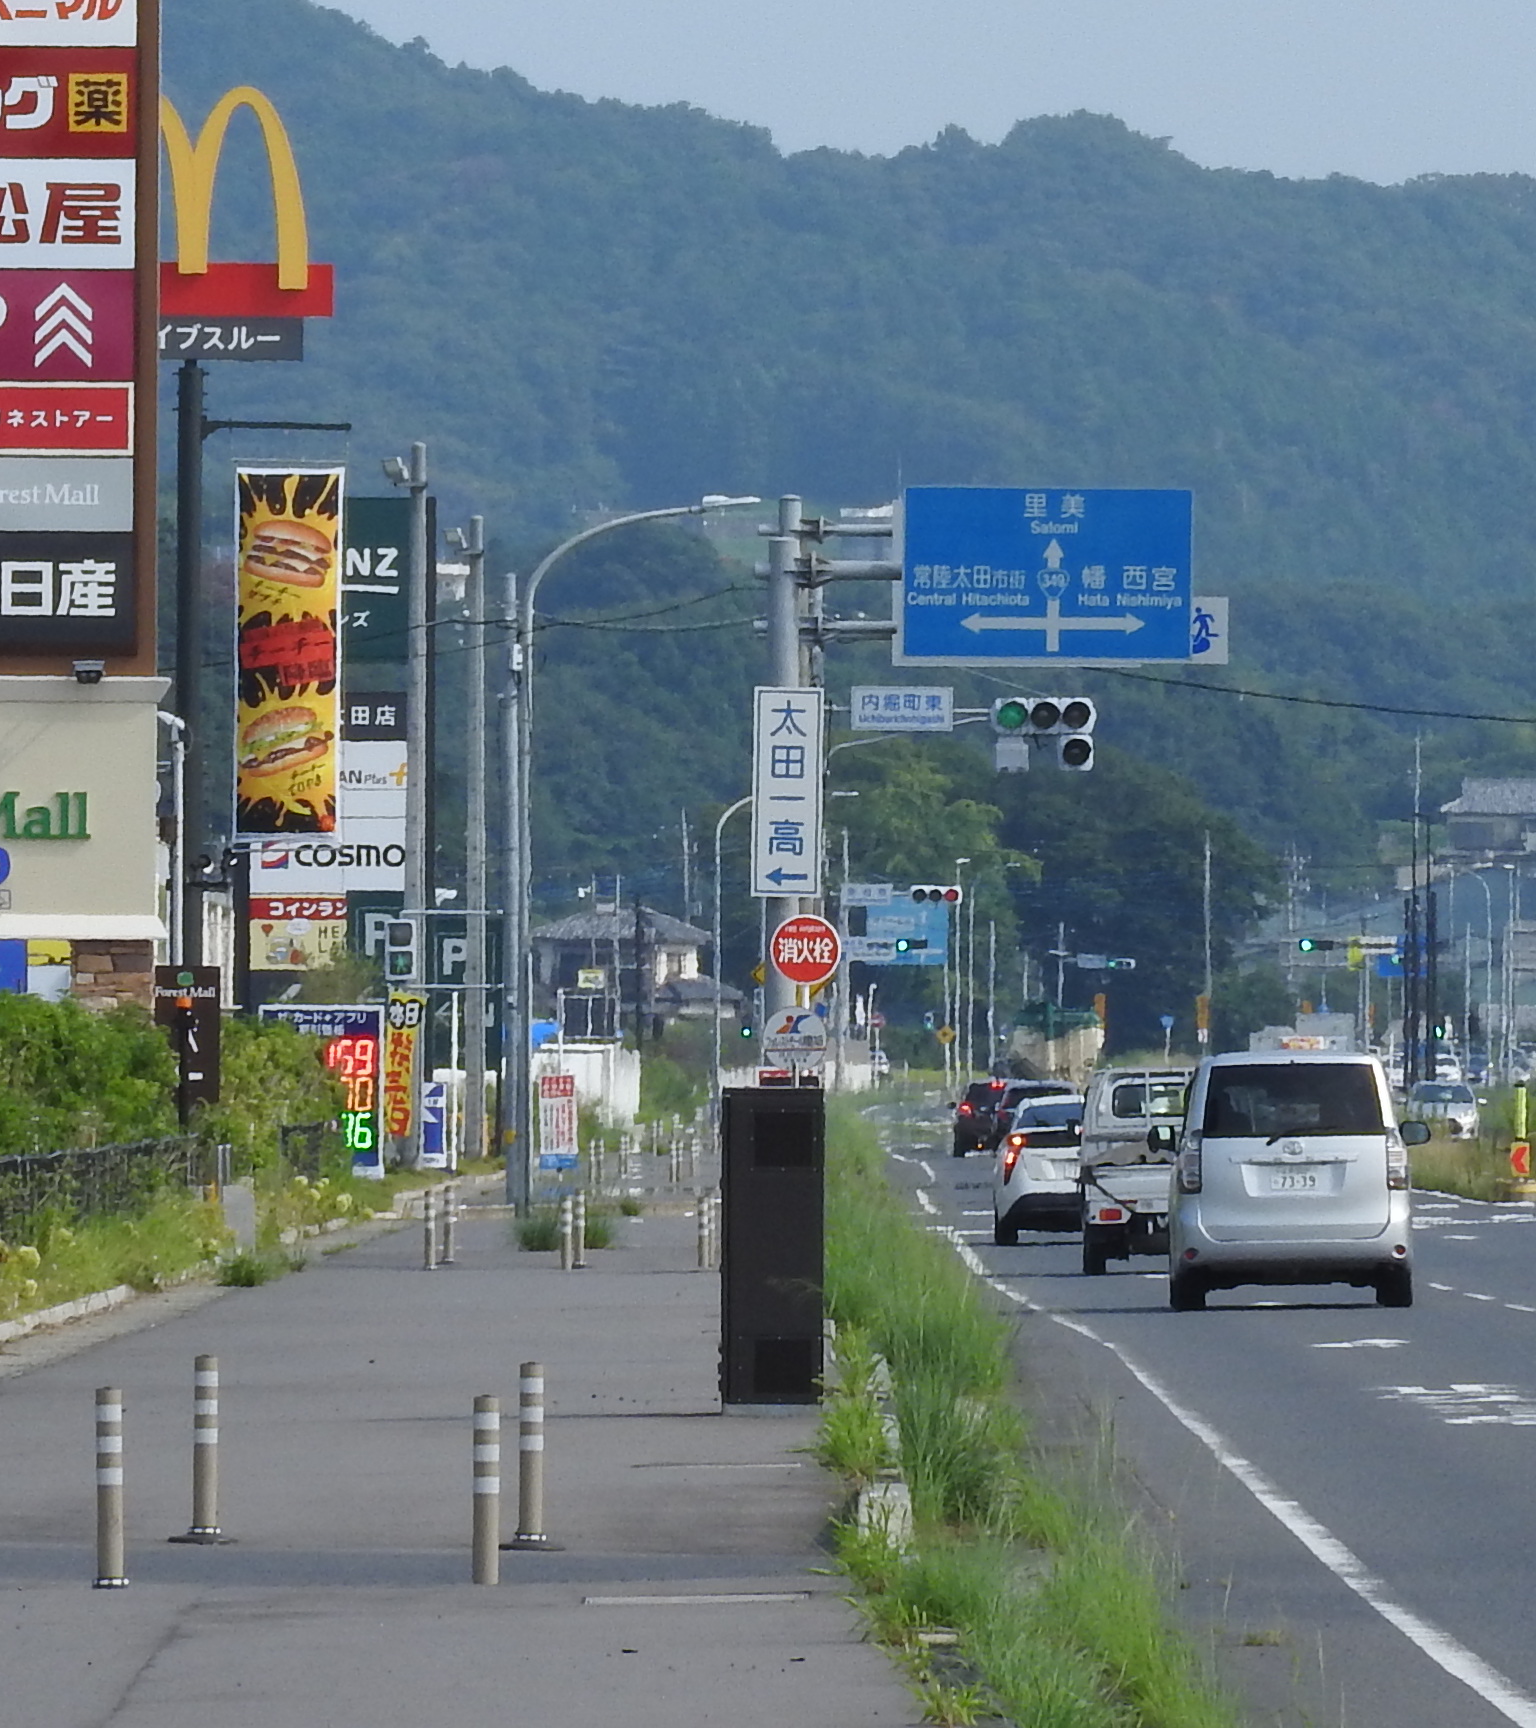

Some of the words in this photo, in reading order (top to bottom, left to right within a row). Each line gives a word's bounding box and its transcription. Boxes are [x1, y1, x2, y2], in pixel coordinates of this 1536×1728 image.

[73, 79, 123, 127] 薬
[44, 483, 100, 506] Mall
[1030, 520, 1079, 534] Satomi
[1122, 565, 1178, 591] 西宮
[907, 591, 956, 606] Central
[962, 591, 1030, 606] Hitachiota
[1078, 593, 1110, 607] Hata
[1116, 593, 1183, 610] Nishimiya
[768, 699, 807, 857] 太田一高
[778, 937, 834, 964] 消火栓
[154, 985, 189, 998] Forest
[190, 985, 216, 998] Mall
